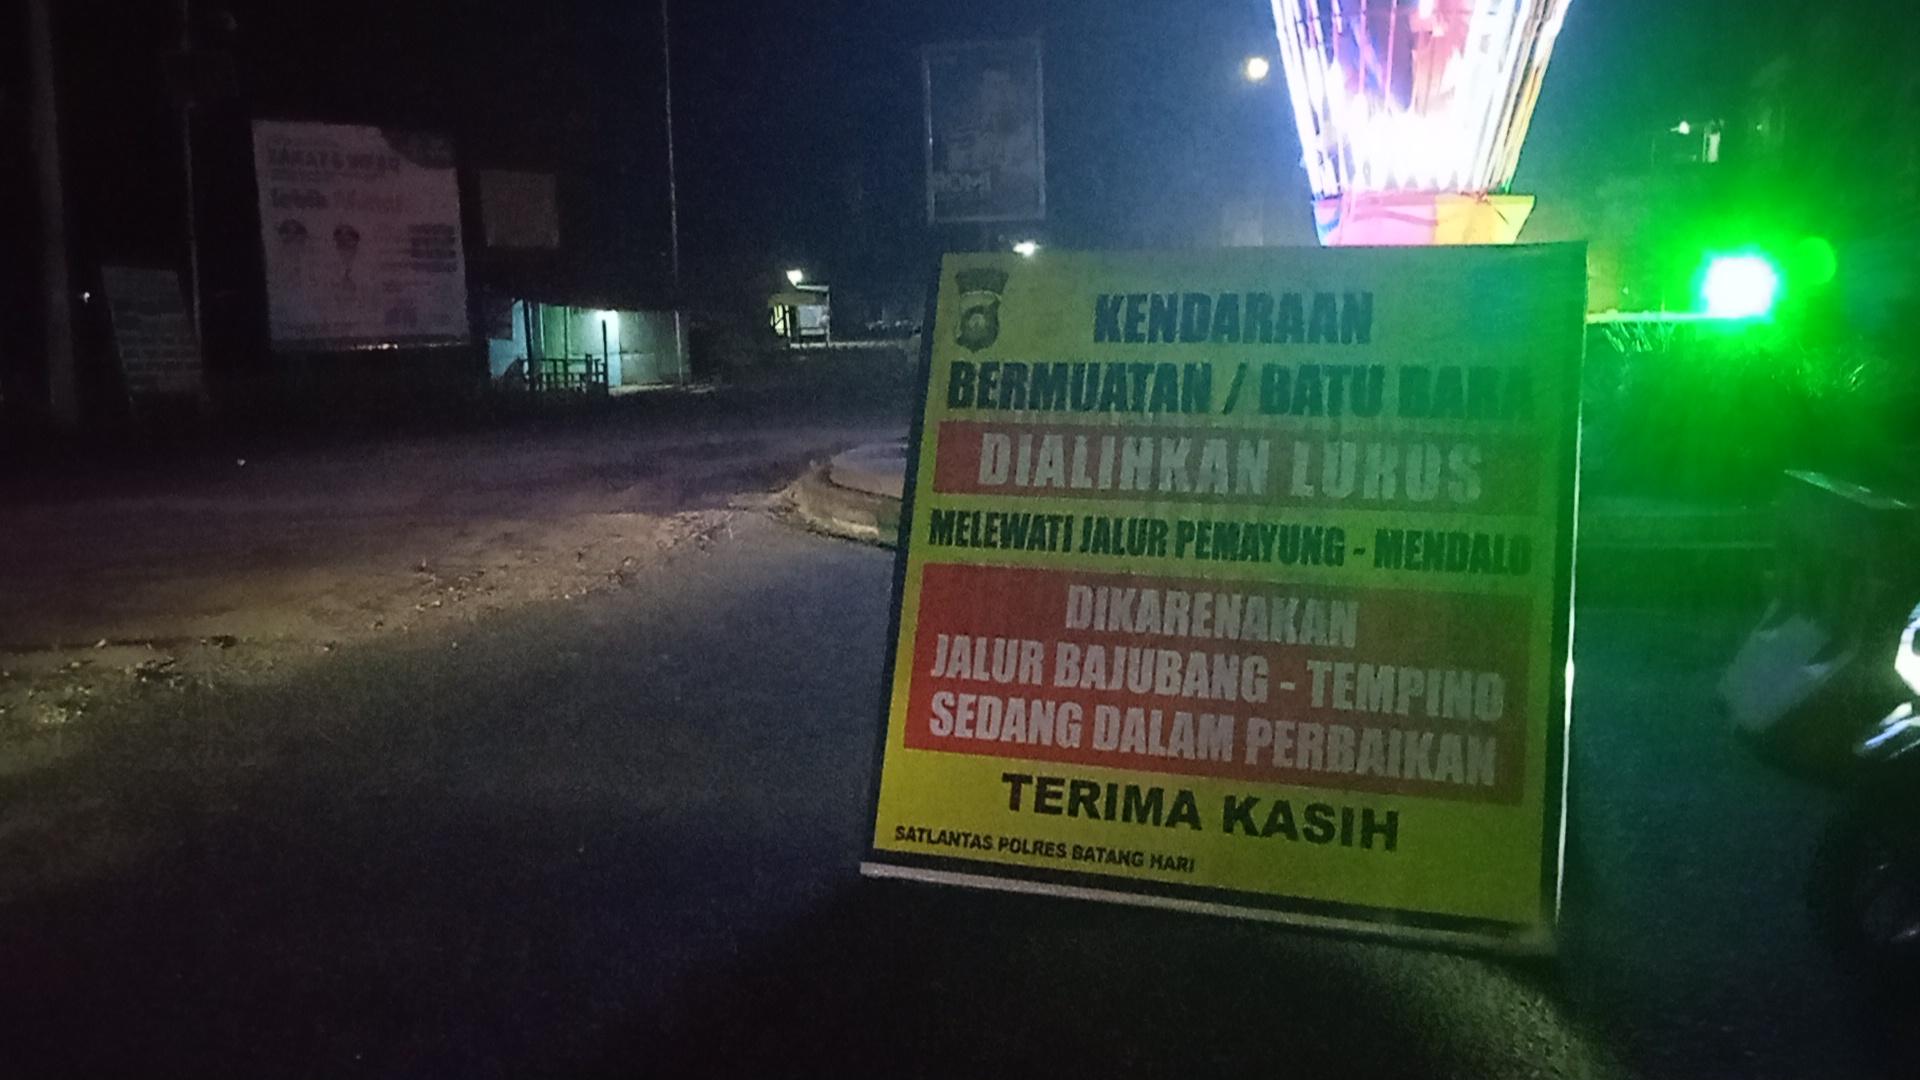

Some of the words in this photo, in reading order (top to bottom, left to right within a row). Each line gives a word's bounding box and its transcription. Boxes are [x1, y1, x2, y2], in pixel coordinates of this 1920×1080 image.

[1094, 292, 1373, 344] KENDARAAN
[947, 360, 1212, 412] BERMUATAN
[1222, 363, 1247, 415] /
[1259, 363, 1386, 418] BATU
[977, 432, 1270, 495] DIALIHKAN
[927, 508, 1073, 553] MELEWATI
[1079, 515, 1169, 556] JALUR
[1175, 519, 1345, 567] PEMAYUNG
[1373, 528, 1533, 576] MENDALO
[1066, 583, 1358, 650] DIKARENAKAN
[930, 633, 1044, 686] JALUR
[1053, 643, 1269, 705] BAJUBANG
[1306, 658, 1505, 723] TEMPINO
[929, 690, 1083, 750] SEDANG
[1098, 703, 1234, 764] DALAM
[1246, 716, 1499, 787] PERBAIKAN
[1001, 772, 1203, 832] TERIMA
[1222, 794, 1400, 851] KASIH
[895, 824, 993, 851] SATLANTAS
[999, 836, 1068, 860] POLRES
[1071, 846, 1145, 869] BATANG
[1149, 853, 1197, 873] HARI
